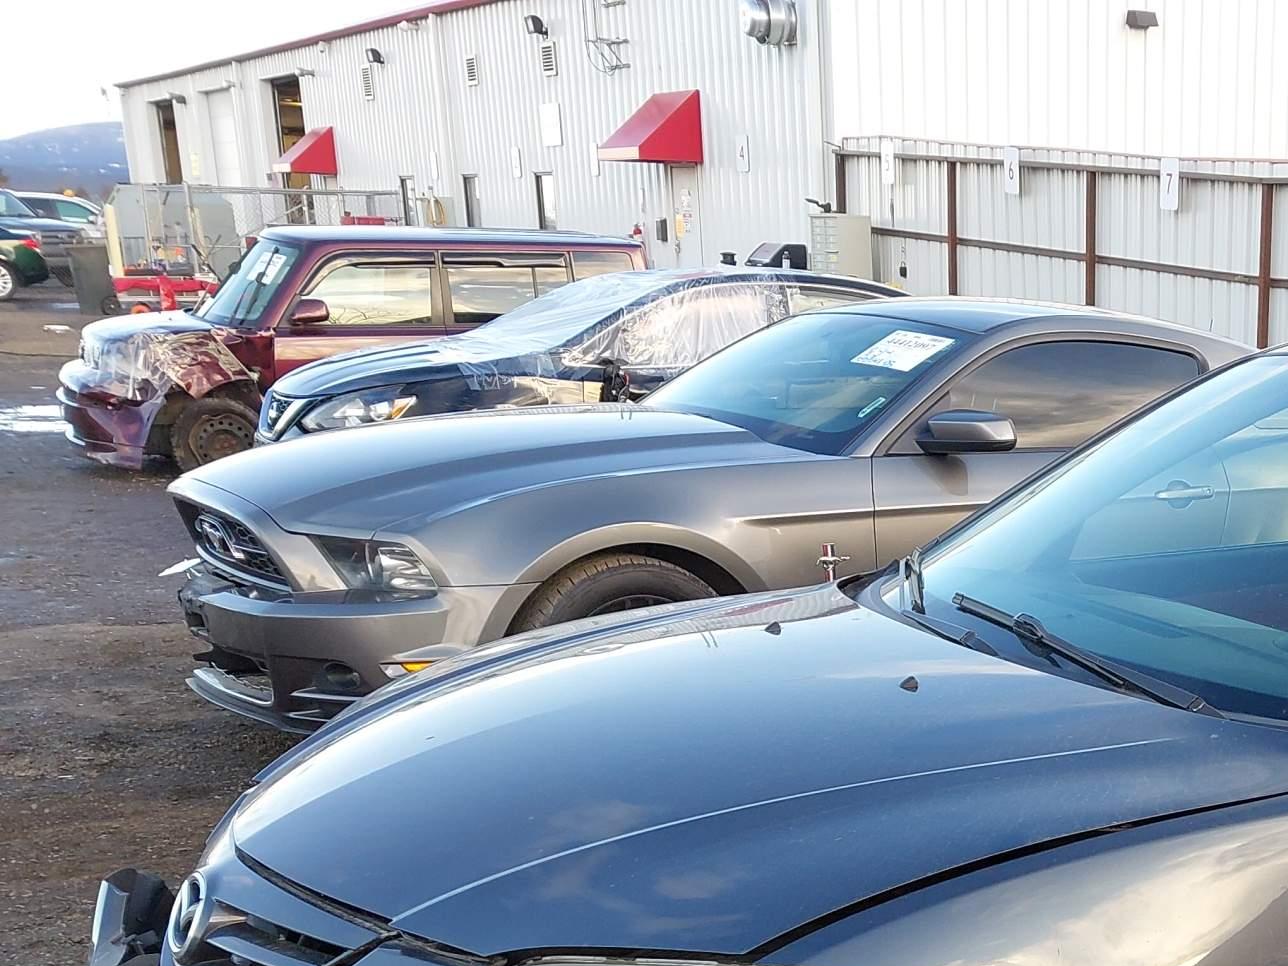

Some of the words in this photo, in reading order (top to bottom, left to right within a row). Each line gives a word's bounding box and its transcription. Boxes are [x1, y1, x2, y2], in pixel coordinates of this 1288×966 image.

[739, 144, 745, 161] 4
[1008, 161, 1014, 180] 6
[1166, 173, 1173, 195] 7
